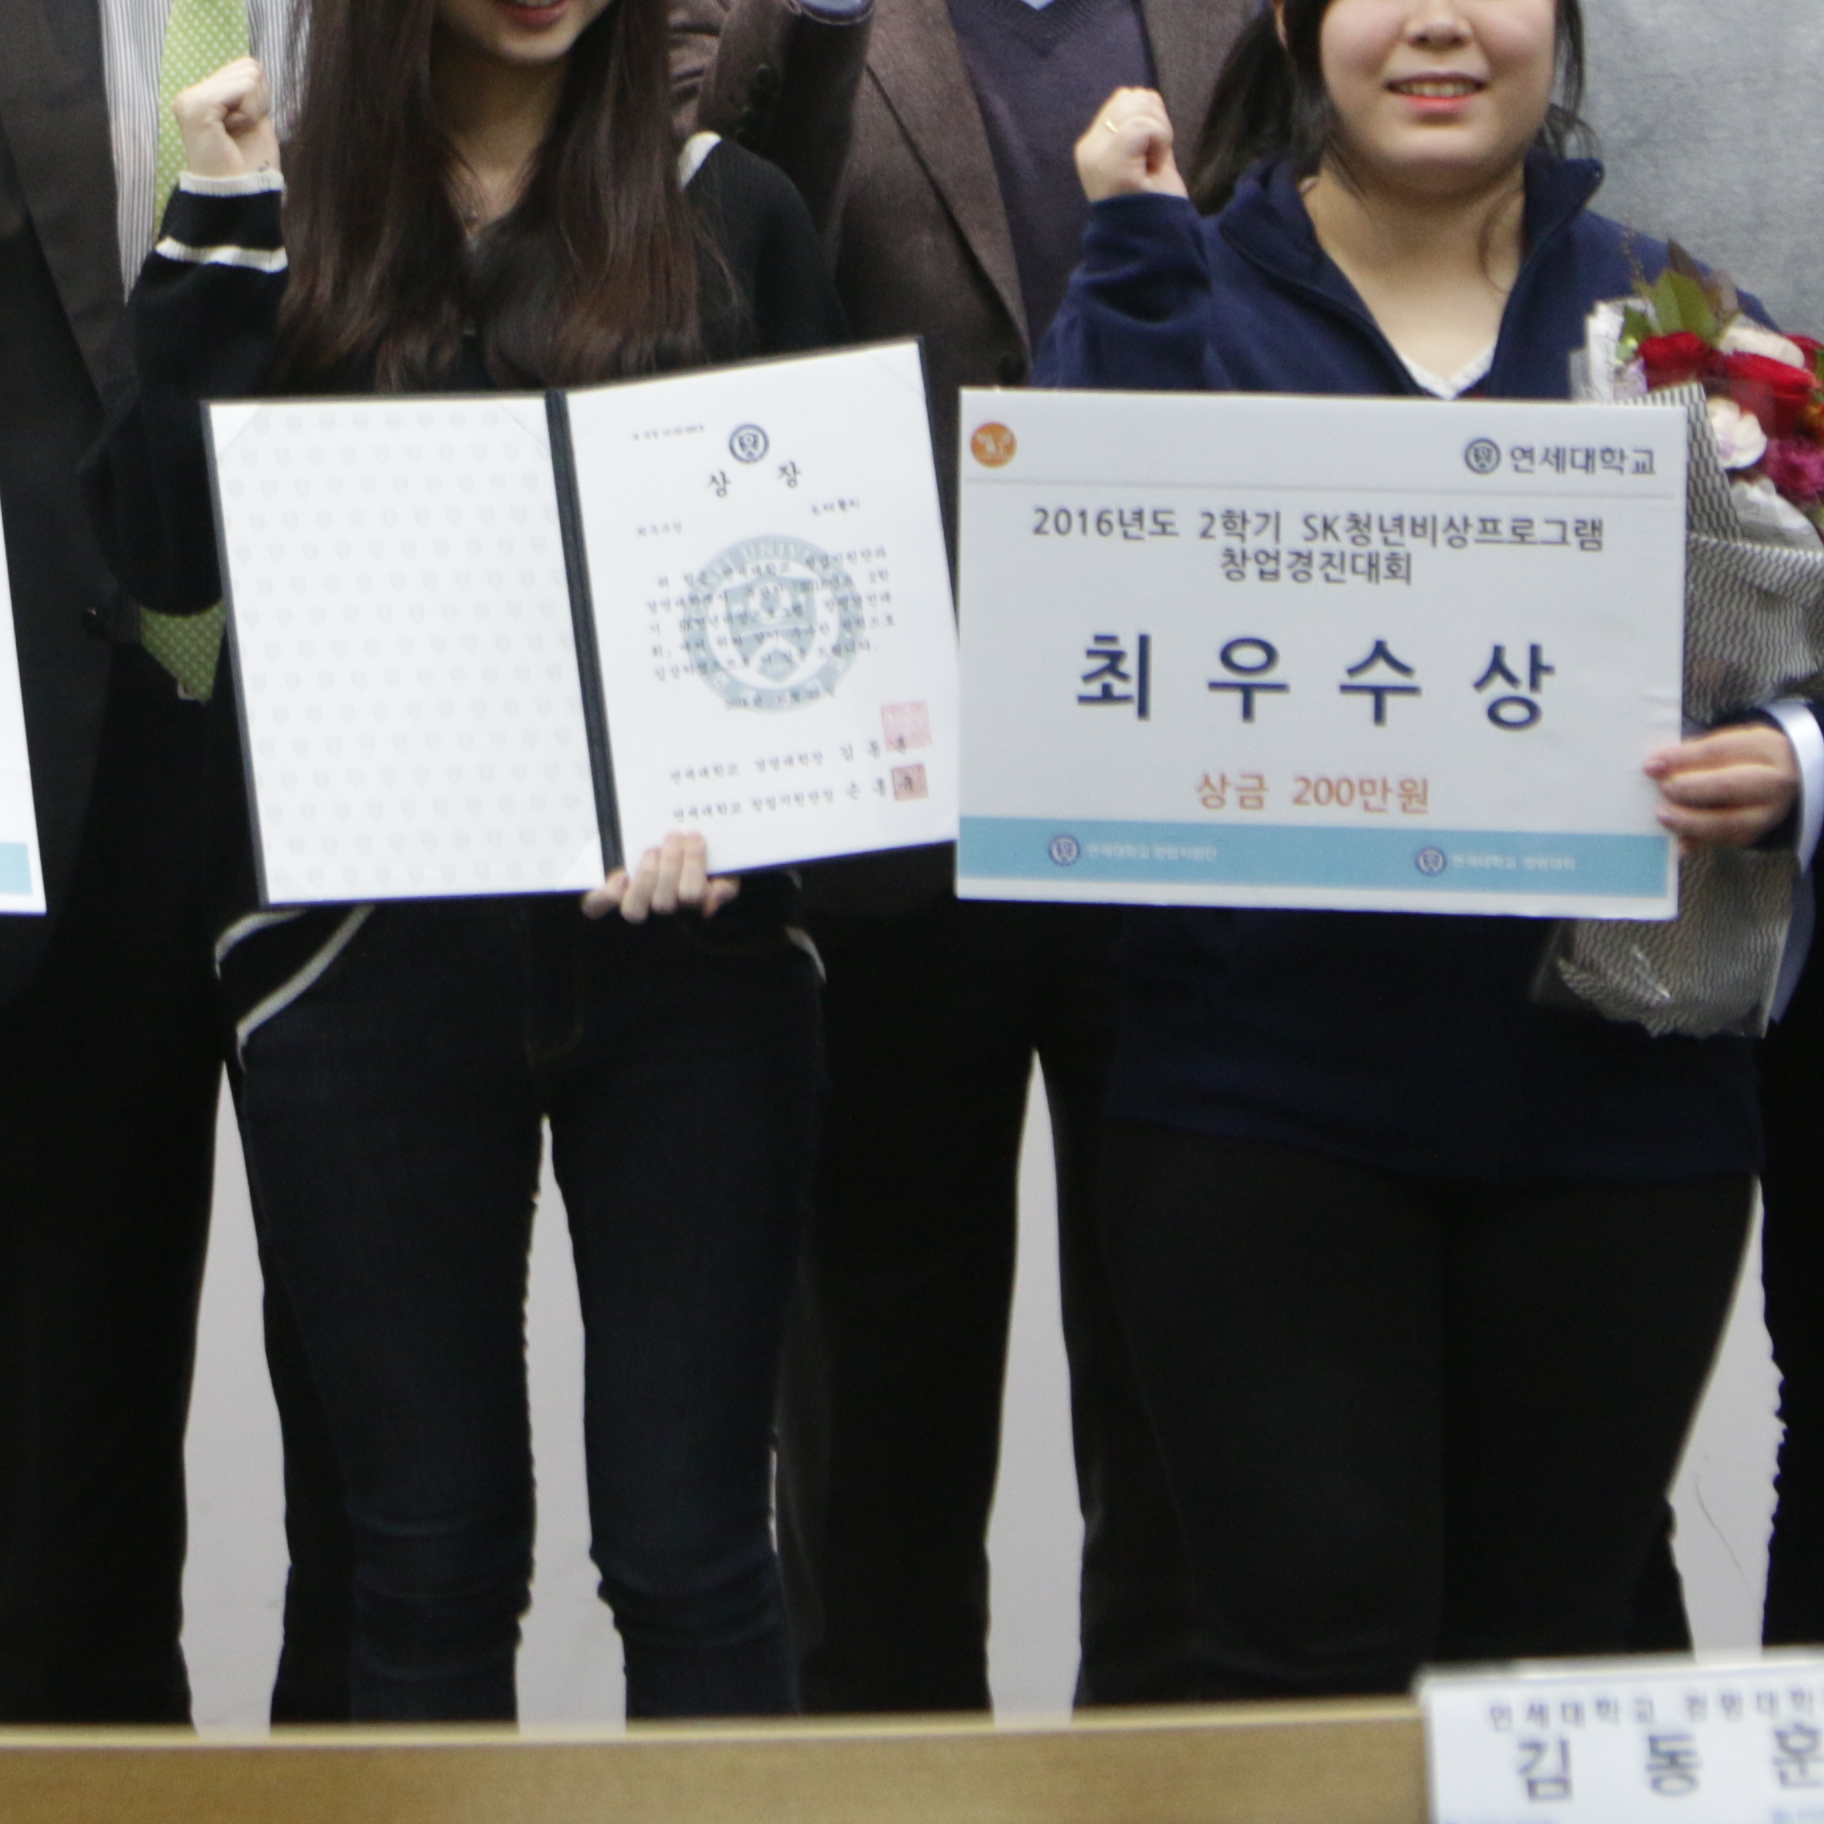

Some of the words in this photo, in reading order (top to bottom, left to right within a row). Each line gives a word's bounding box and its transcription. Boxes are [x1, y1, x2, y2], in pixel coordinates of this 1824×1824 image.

[1509, 446, 1657, 477] 연세대학교
[1032, 508, 1180, 541] 2016년도
[1199, 510, 1283, 545] 2학기
[1302, 512, 1606, 552] SK청년비상프로그램
[1220, 549, 1414, 586] 창업경진대회
[1196, 773, 1271, 810] 상금
[1291, 776, 1431, 815] 200만원
